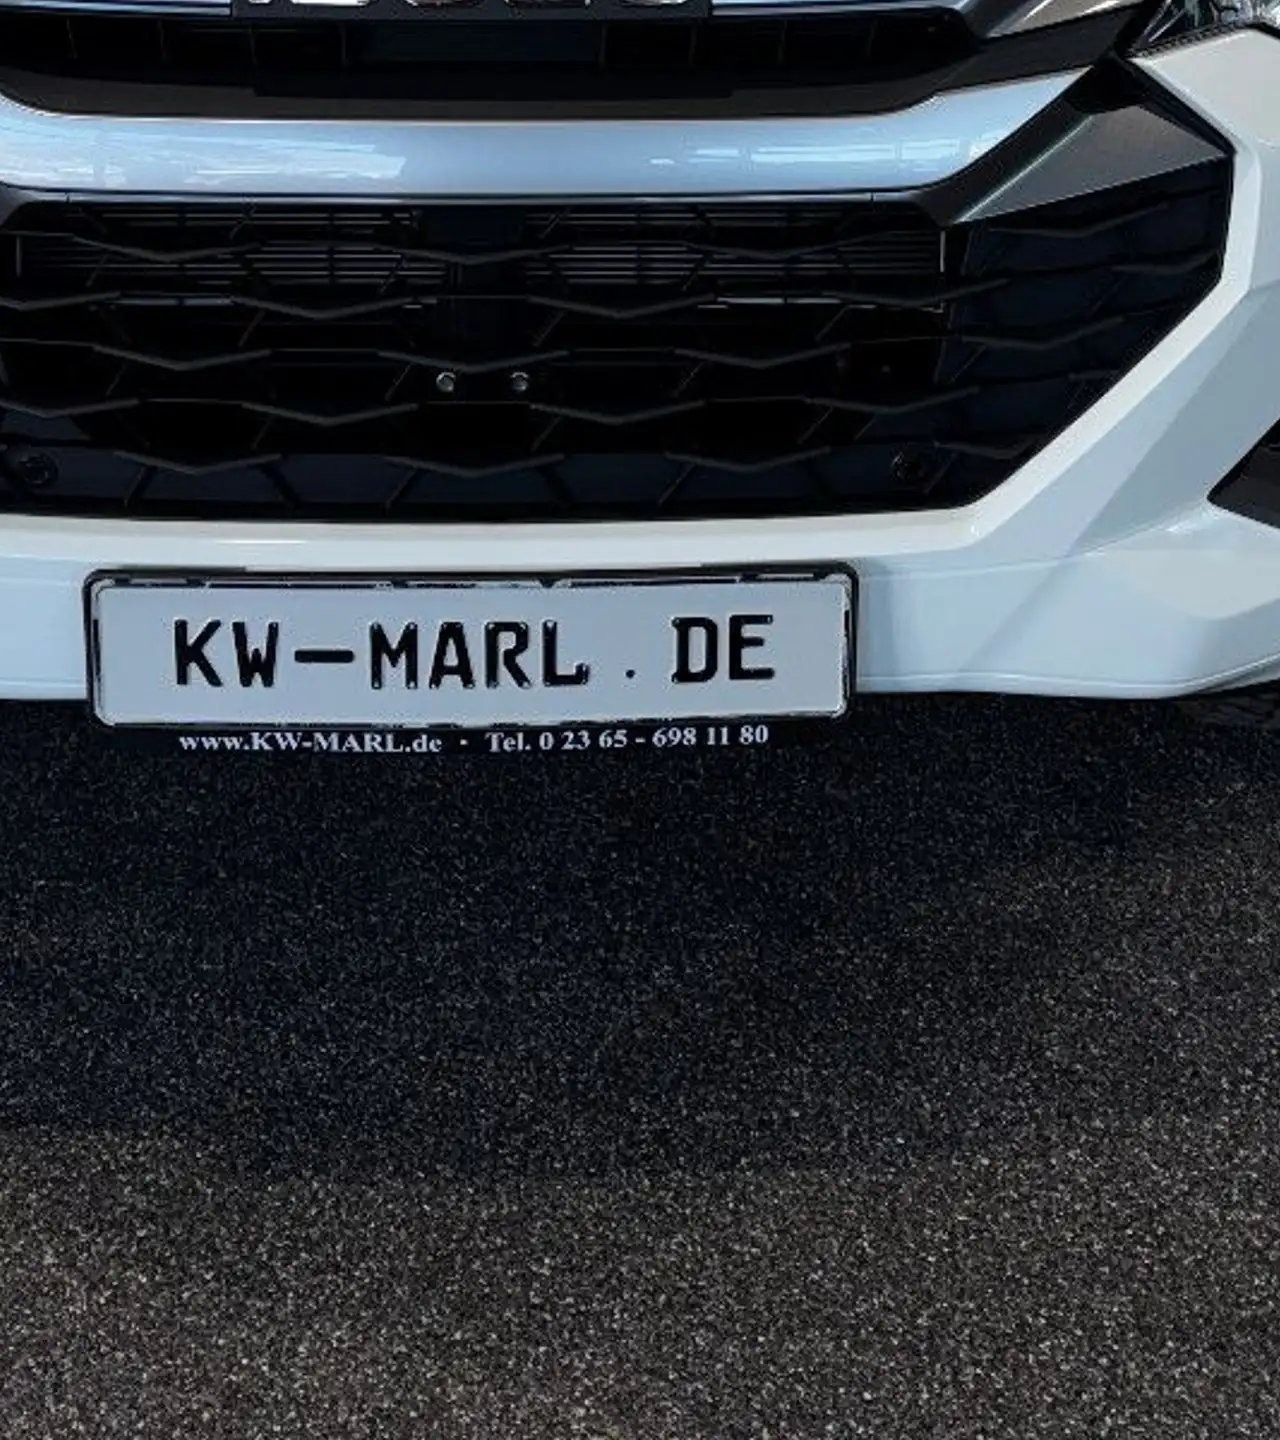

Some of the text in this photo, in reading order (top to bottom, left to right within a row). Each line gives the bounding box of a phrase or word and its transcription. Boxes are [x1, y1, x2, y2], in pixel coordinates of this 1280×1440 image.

[178, 731, 443, 753] www.KW-MARL.de
[484, 731, 532, 753] Tel.
[538, 731, 555, 751] 0
[560, 730, 592, 751] 23
[598, 728, 629, 749] 65
[651, 726, 698, 748] 698
[706, 725, 731, 746] 11
[738, 723, 770, 745] 80
